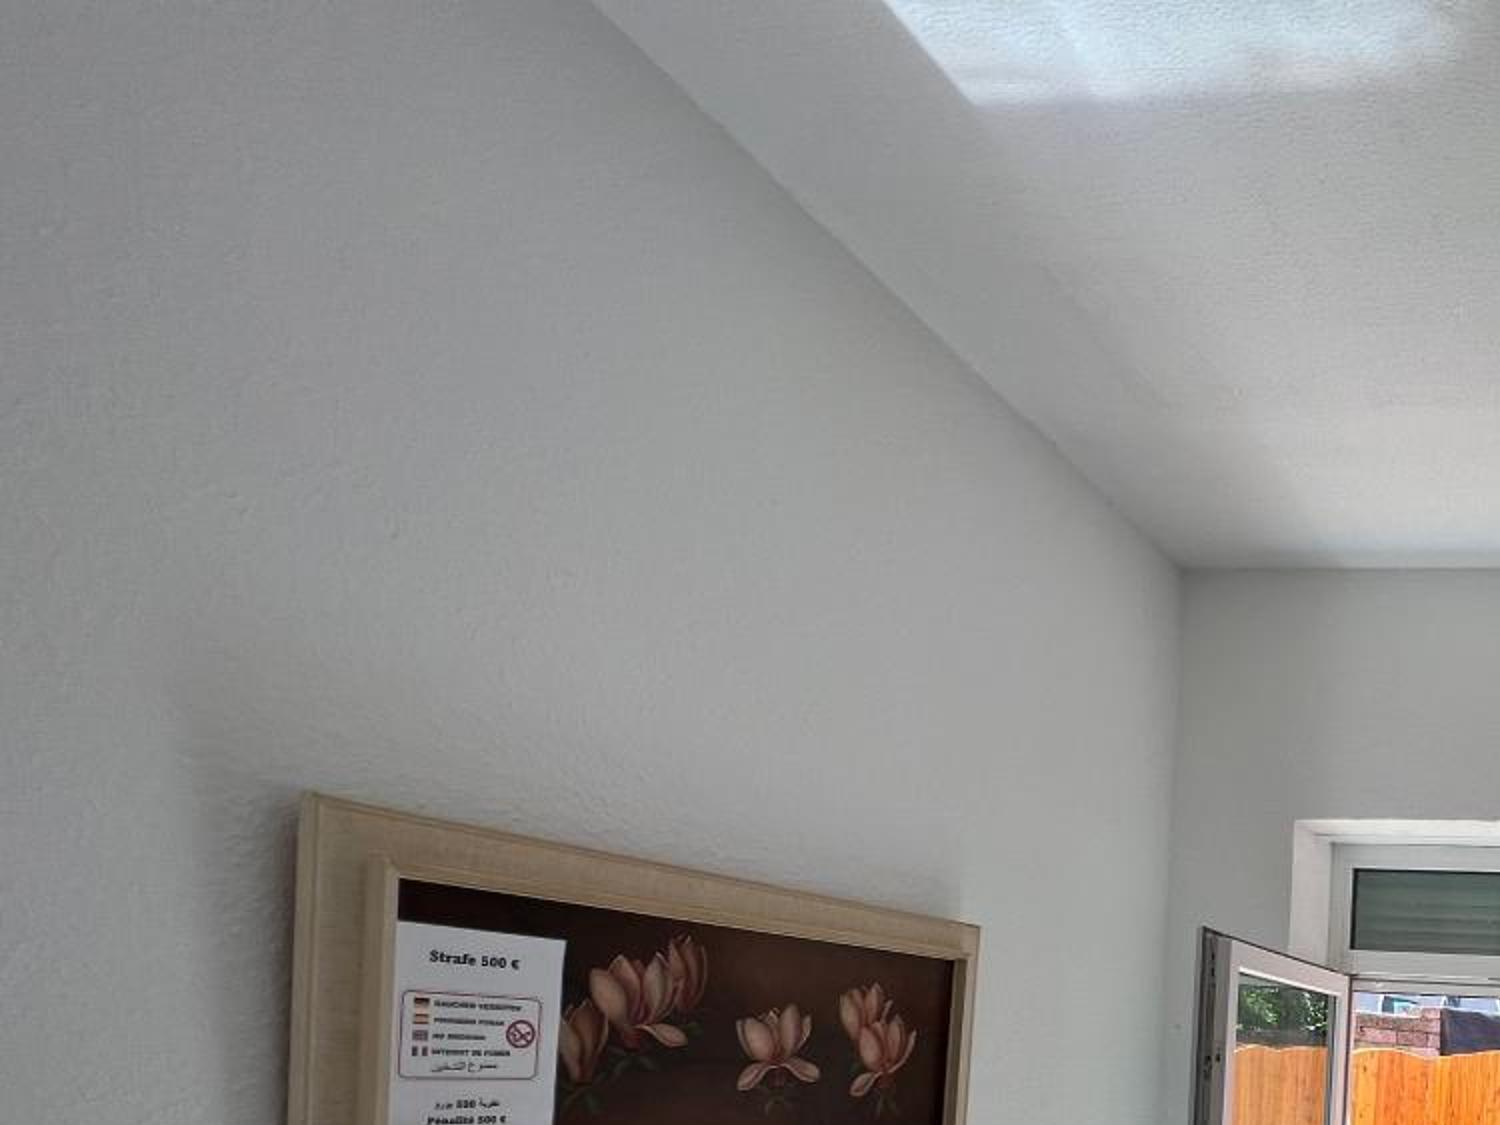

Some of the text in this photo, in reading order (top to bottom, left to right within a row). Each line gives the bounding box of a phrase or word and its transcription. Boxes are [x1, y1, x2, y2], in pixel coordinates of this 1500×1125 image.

[429, 949, 476, 966] Strafe
[481, 955, 507, 968] 500
[478, 1115, 497, 1125] 500
